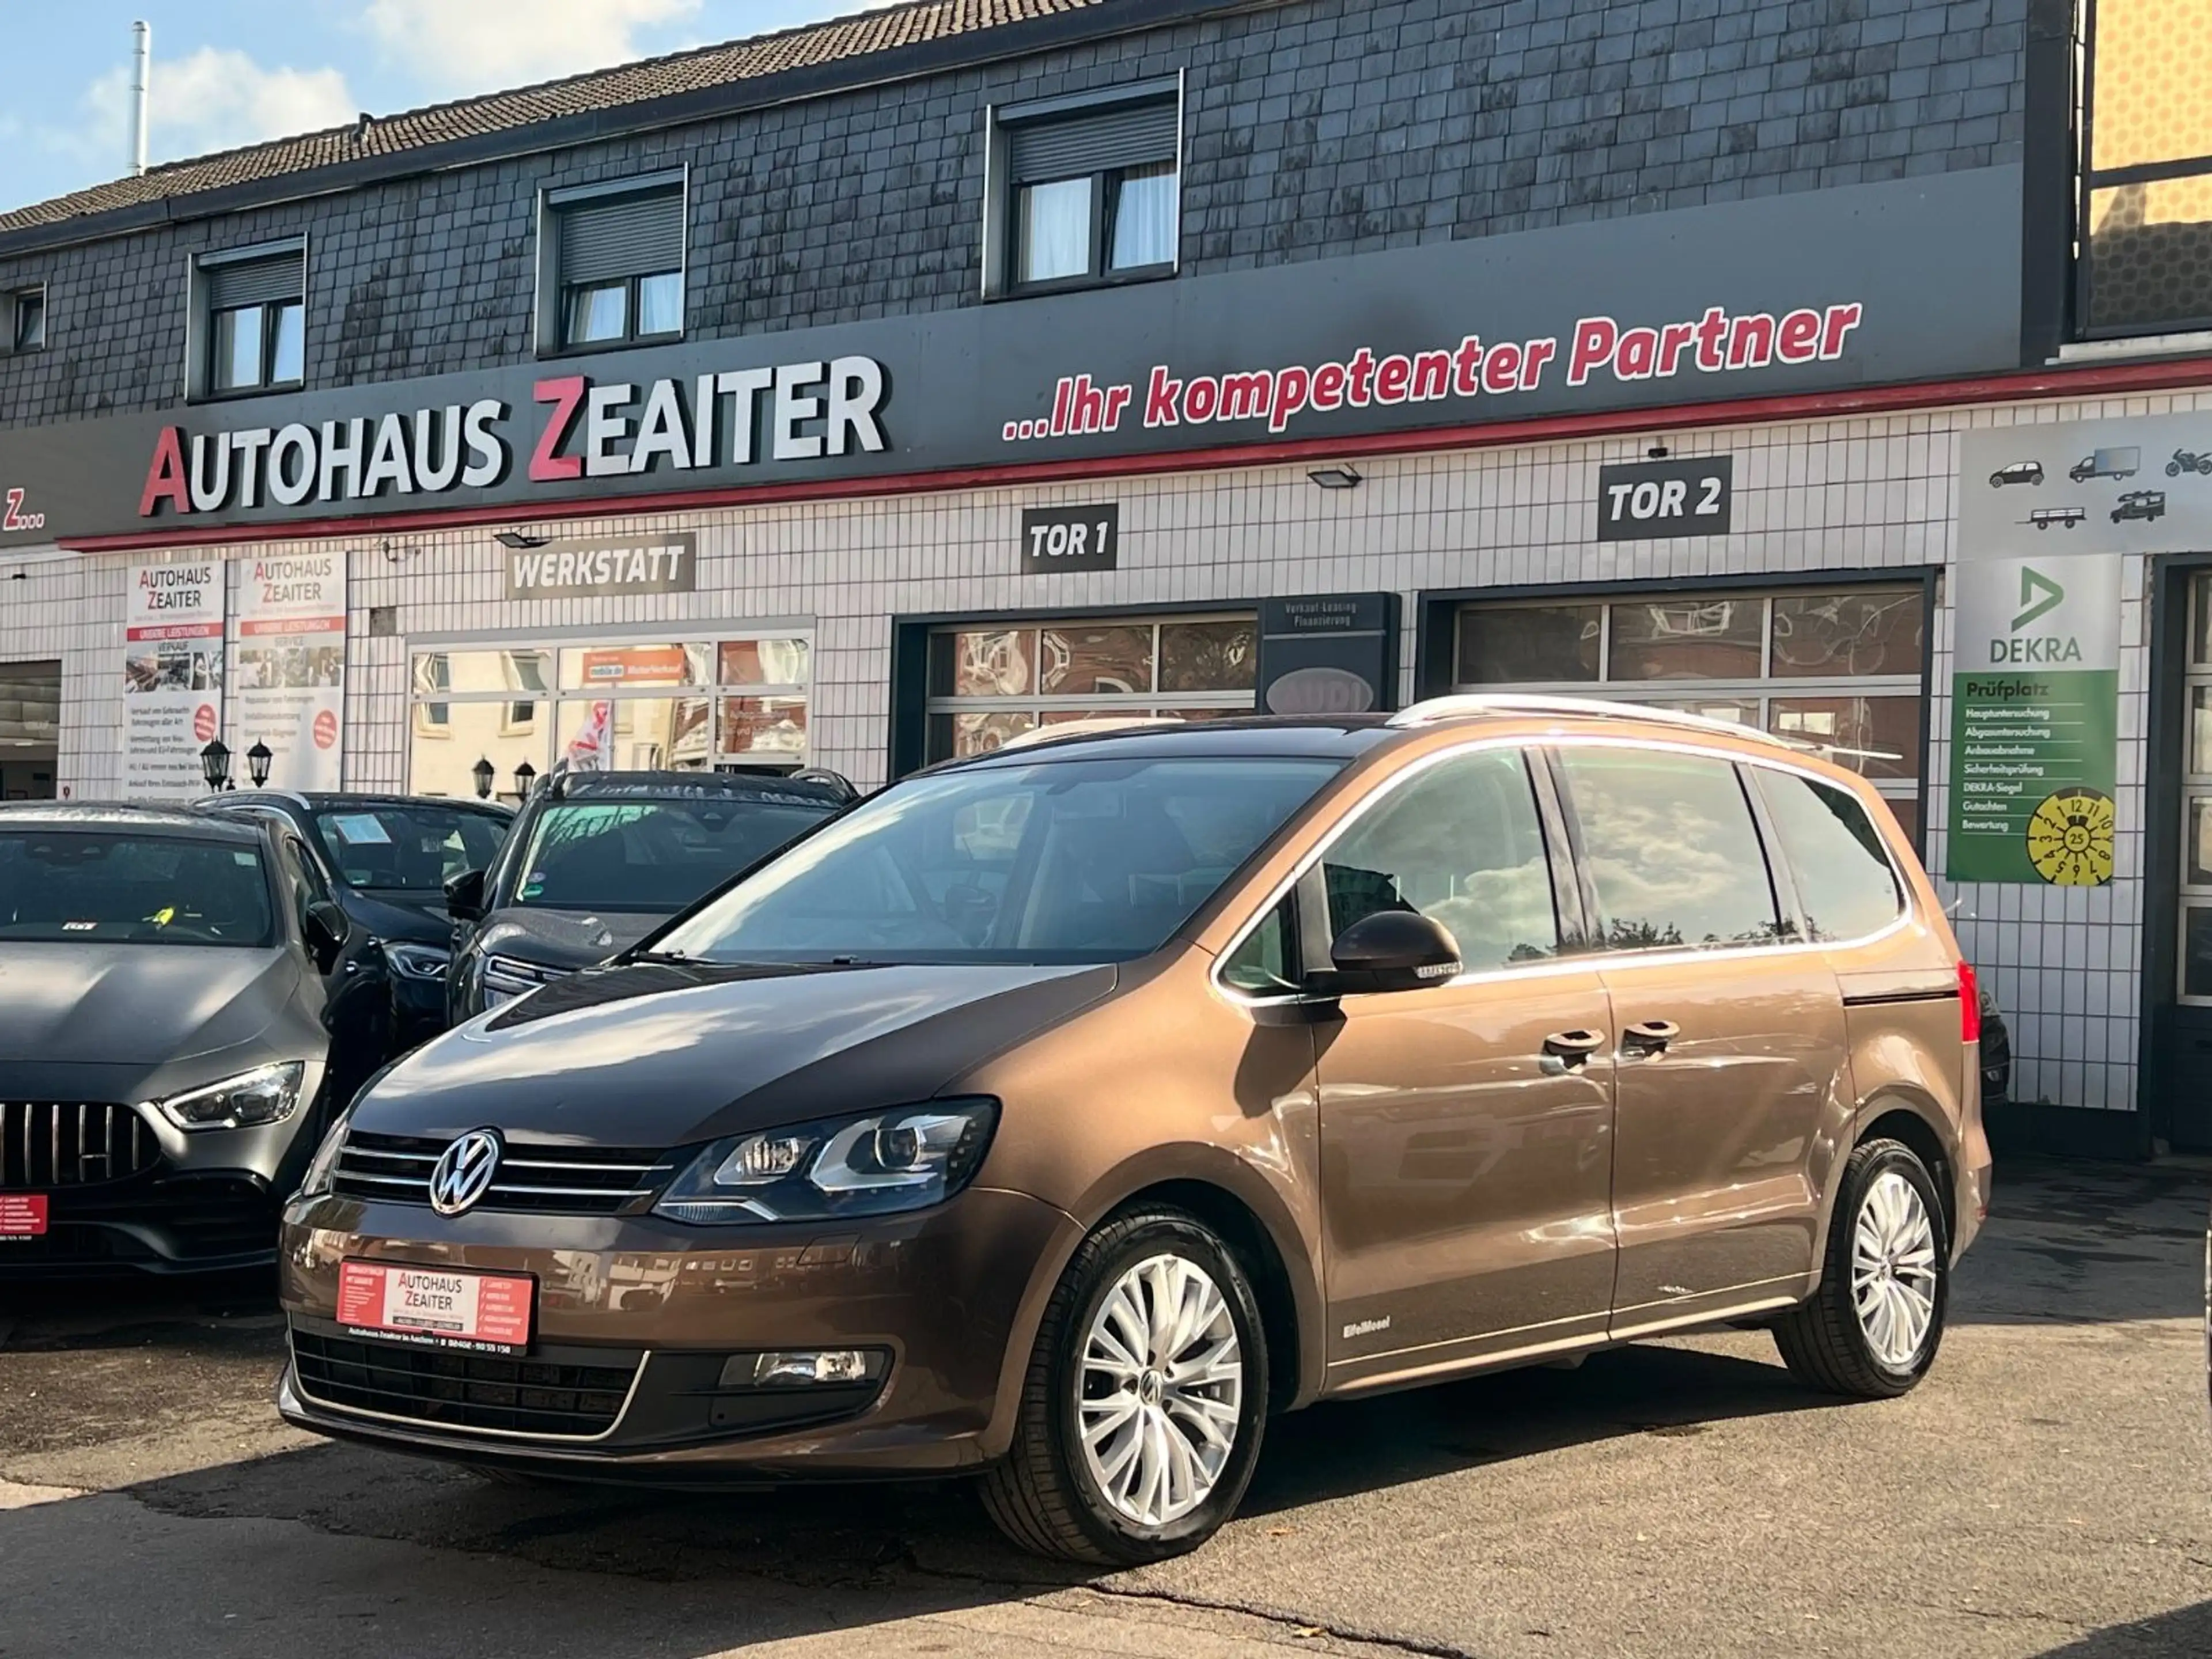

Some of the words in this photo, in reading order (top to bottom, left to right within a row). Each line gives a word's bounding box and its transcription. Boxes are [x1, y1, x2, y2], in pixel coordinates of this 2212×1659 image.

[1003, 374, 1132, 441] ...Ihr
[1143, 335, 1556, 433] kompetenter
[1567, 302, 1862, 387] Partner
[138, 399, 503, 517] AUTOHAUS
[529, 355, 885, 482] ZEAITER
[1608, 479, 1687, 521] TOR
[1695, 476, 1721, 514] 2
[1030, 524, 1085, 556] TOR
[1096, 521, 1108, 554] 1
[254, 559, 332, 581] AUTOHAUS
[513, 545, 685, 588] WERKSTATT
[139, 567, 211, 589] AUTOHAUS
[147, 590, 202, 610] ZEAITER
[263, 582, 321, 604] ZEAITER
[1990, 637, 2083, 664] DEKRA
[1967, 680, 2049, 701] Prüfplatz
[1965, 707, 2050, 720] Hauptuntersuchung
[1965, 725, 2051, 739] Abgasuntersuchung
[1963, 782, 2023, 795] DEKRA-Siegel
[1962, 800, 2008, 812] Gutachten
[2070, 799, 2084, 813] 12
[2087, 802, 2100, 817] 11
[1961, 819, 2009, 832] Bewertung
[2043, 817, 2057, 830] 2
[2099, 814, 2113, 831] 10
[2039, 835, 2053, 843] 3
[2069, 833, 2084, 844] 25
[2097, 849, 2112, 861] 8
[2055, 860, 2067, 874] 5
[398, 1272, 463, 1294] AUTOHAUS
[405, 1290, 453, 1311] ZEAITER
